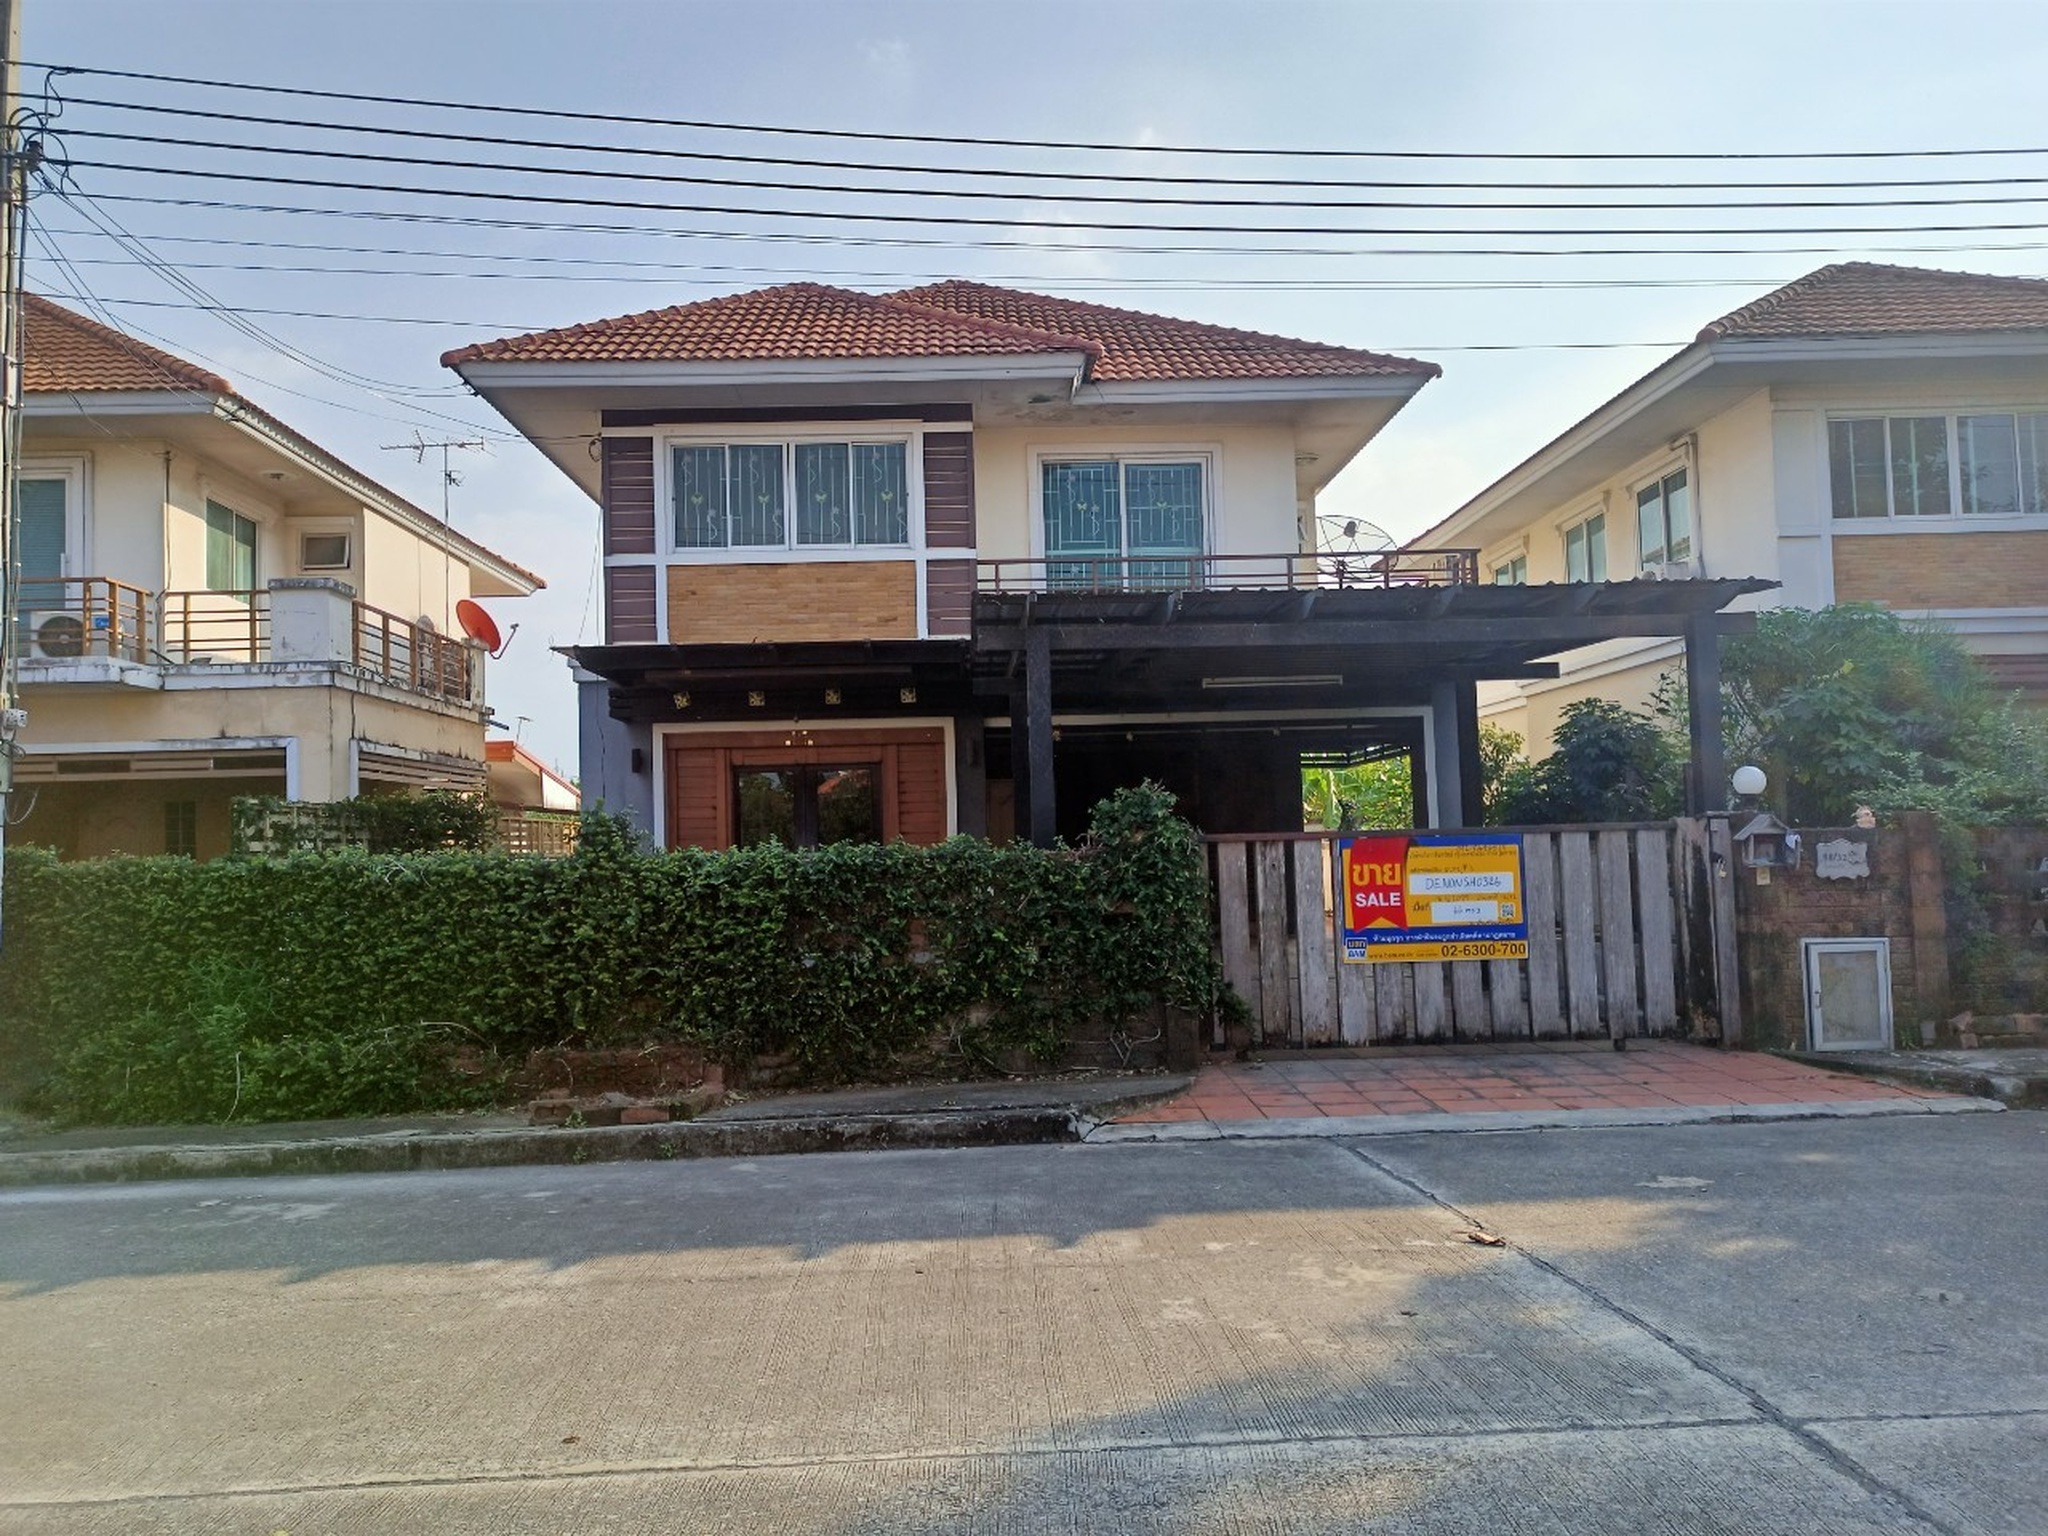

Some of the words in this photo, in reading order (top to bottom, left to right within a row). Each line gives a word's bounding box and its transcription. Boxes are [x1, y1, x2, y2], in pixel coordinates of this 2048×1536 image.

[1352, 863, 1401, 886] ขาย
[1355, 892, 1401, 907] SALE
[1441, 943, 1526, 957] 02-6300-700
